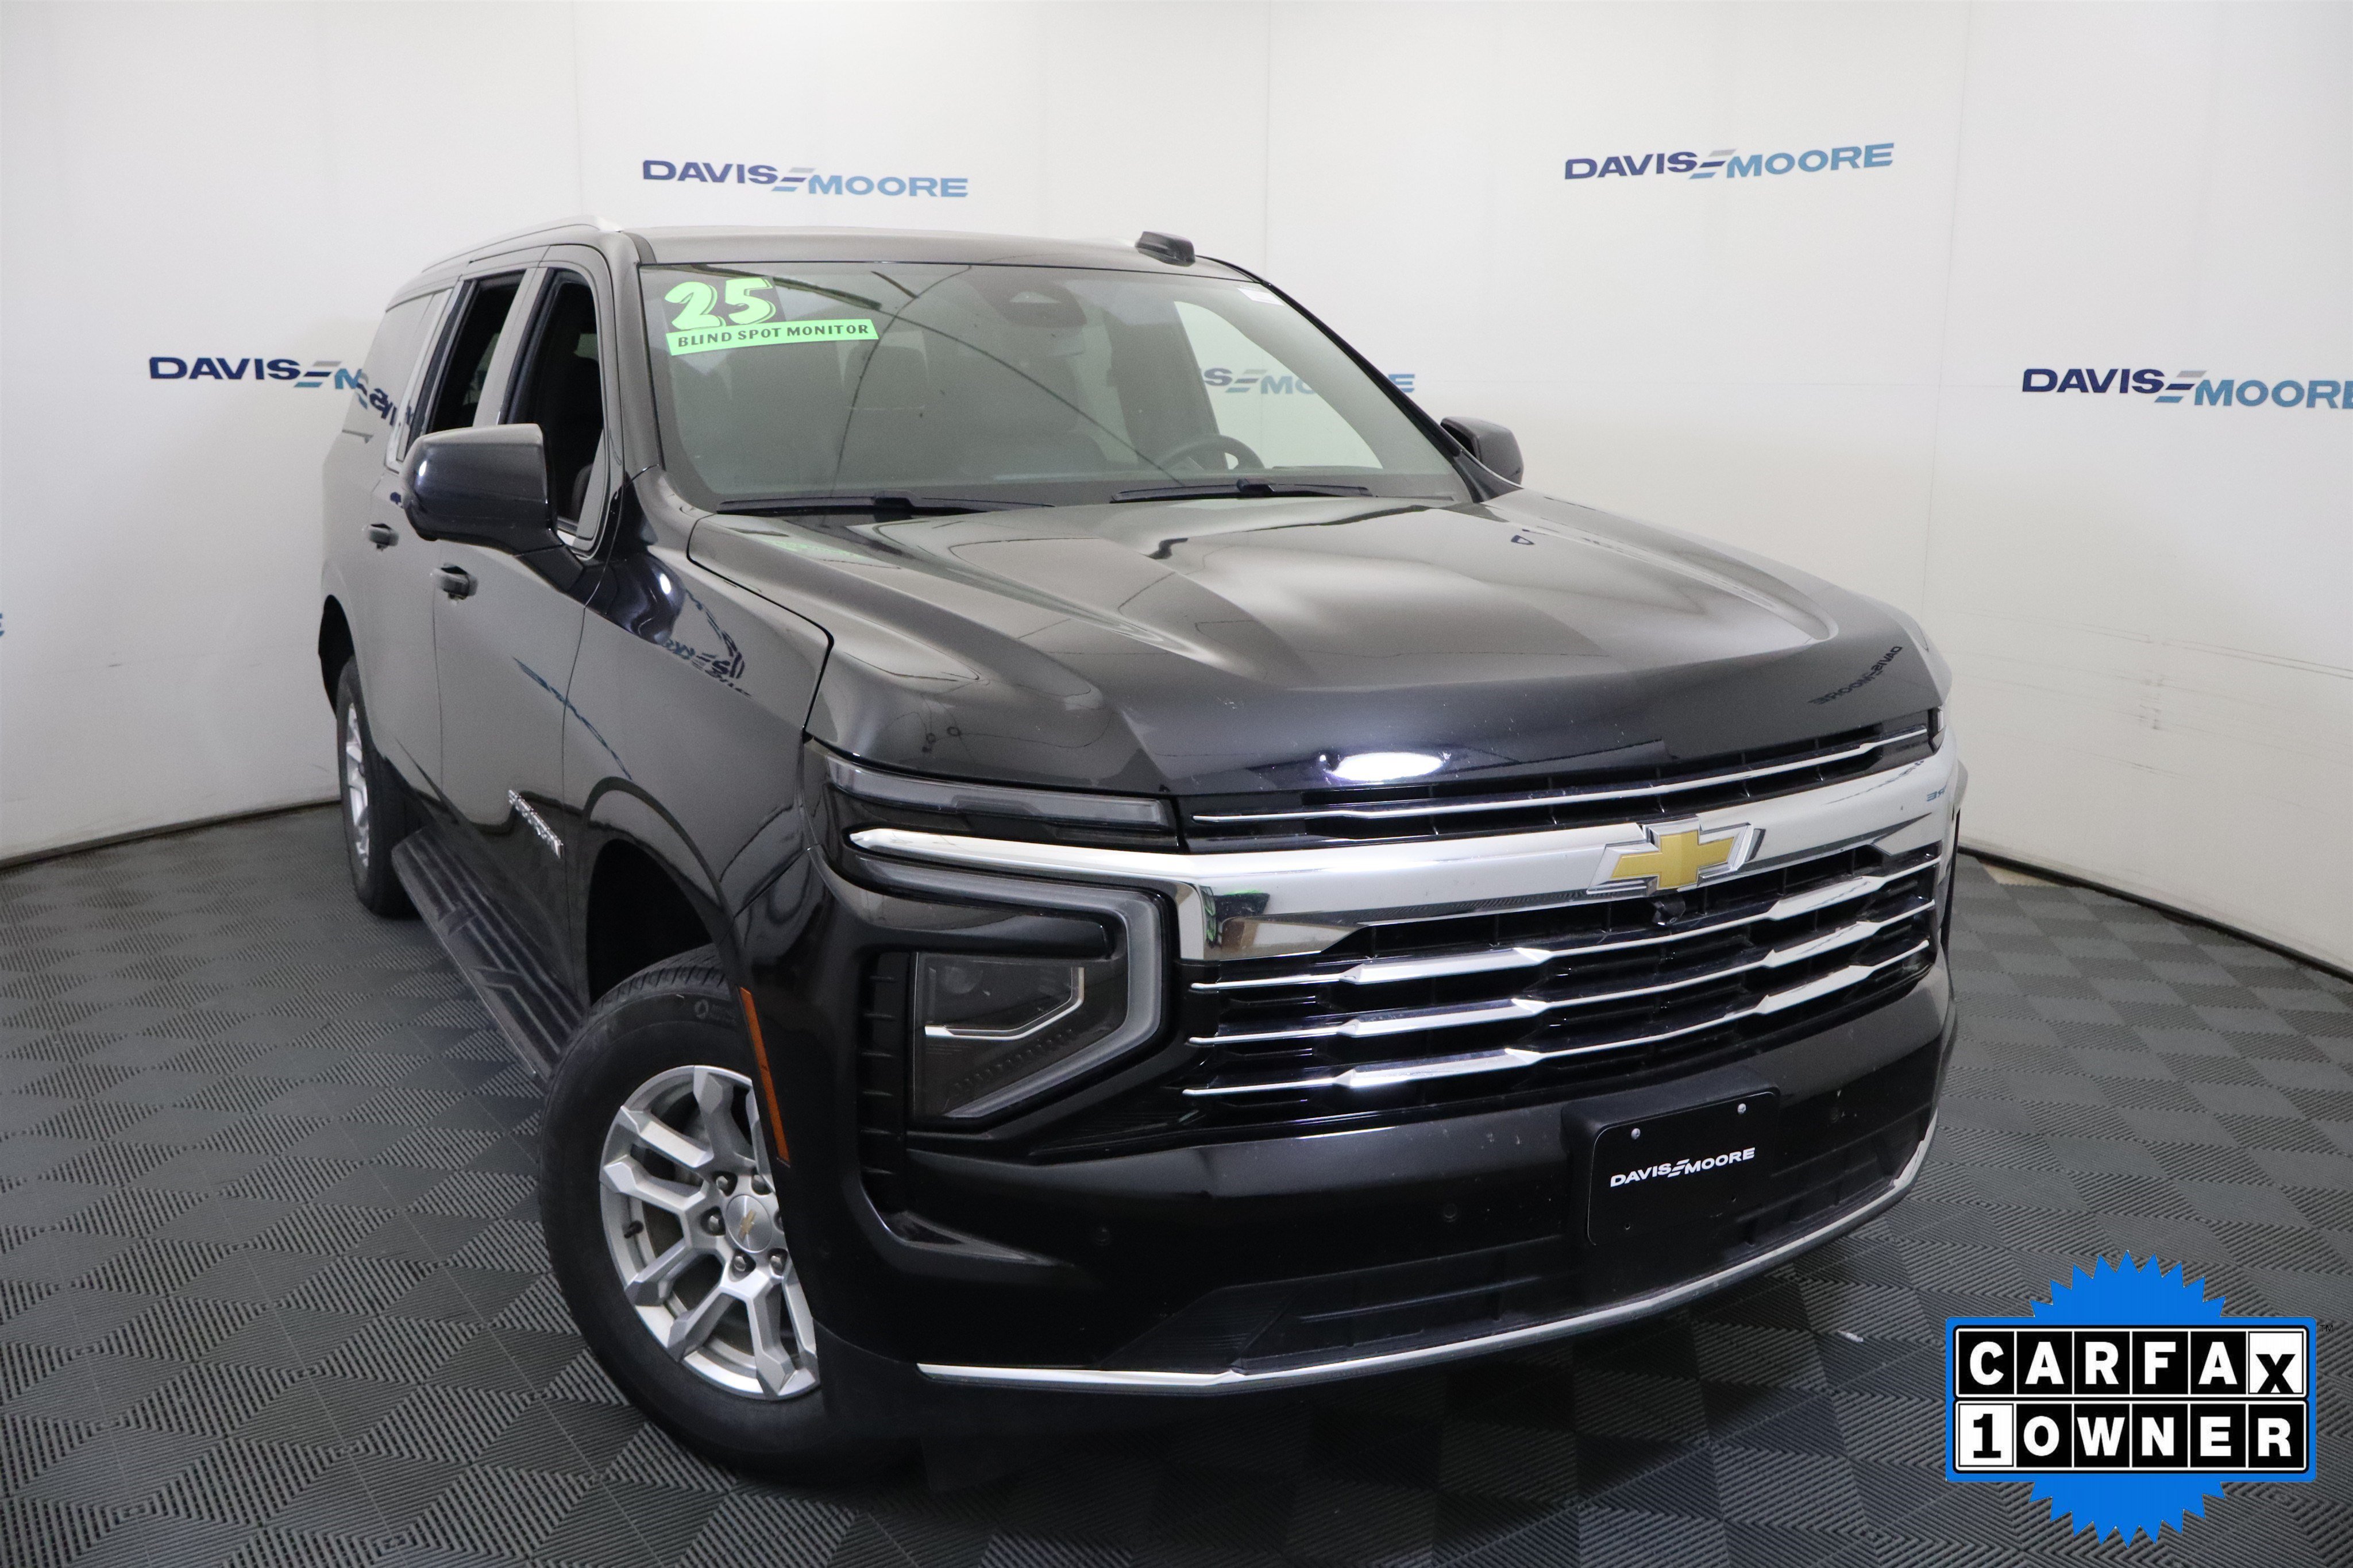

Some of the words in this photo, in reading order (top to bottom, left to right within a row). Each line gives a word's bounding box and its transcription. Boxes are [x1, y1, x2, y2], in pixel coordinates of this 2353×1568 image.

[642, 160, 778, 184] DAVIS
[808, 175, 969, 198] MOORE
[1564, 151, 1698, 180] DAVIS
[1726, 142, 1895, 179] MOORE
[665, 278, 776, 331] 25
[677, 332, 732, 347] BLIND
[738, 327, 781, 340] SPOT
[786, 324, 869, 337] MONITOR
[149, 357, 301, 380] DAVIS
[2022, 368, 2165, 394] DAVIS
[1610, 1163, 1672, 1187] DAVIS
[1684, 1147, 1756, 1175] MOORE
